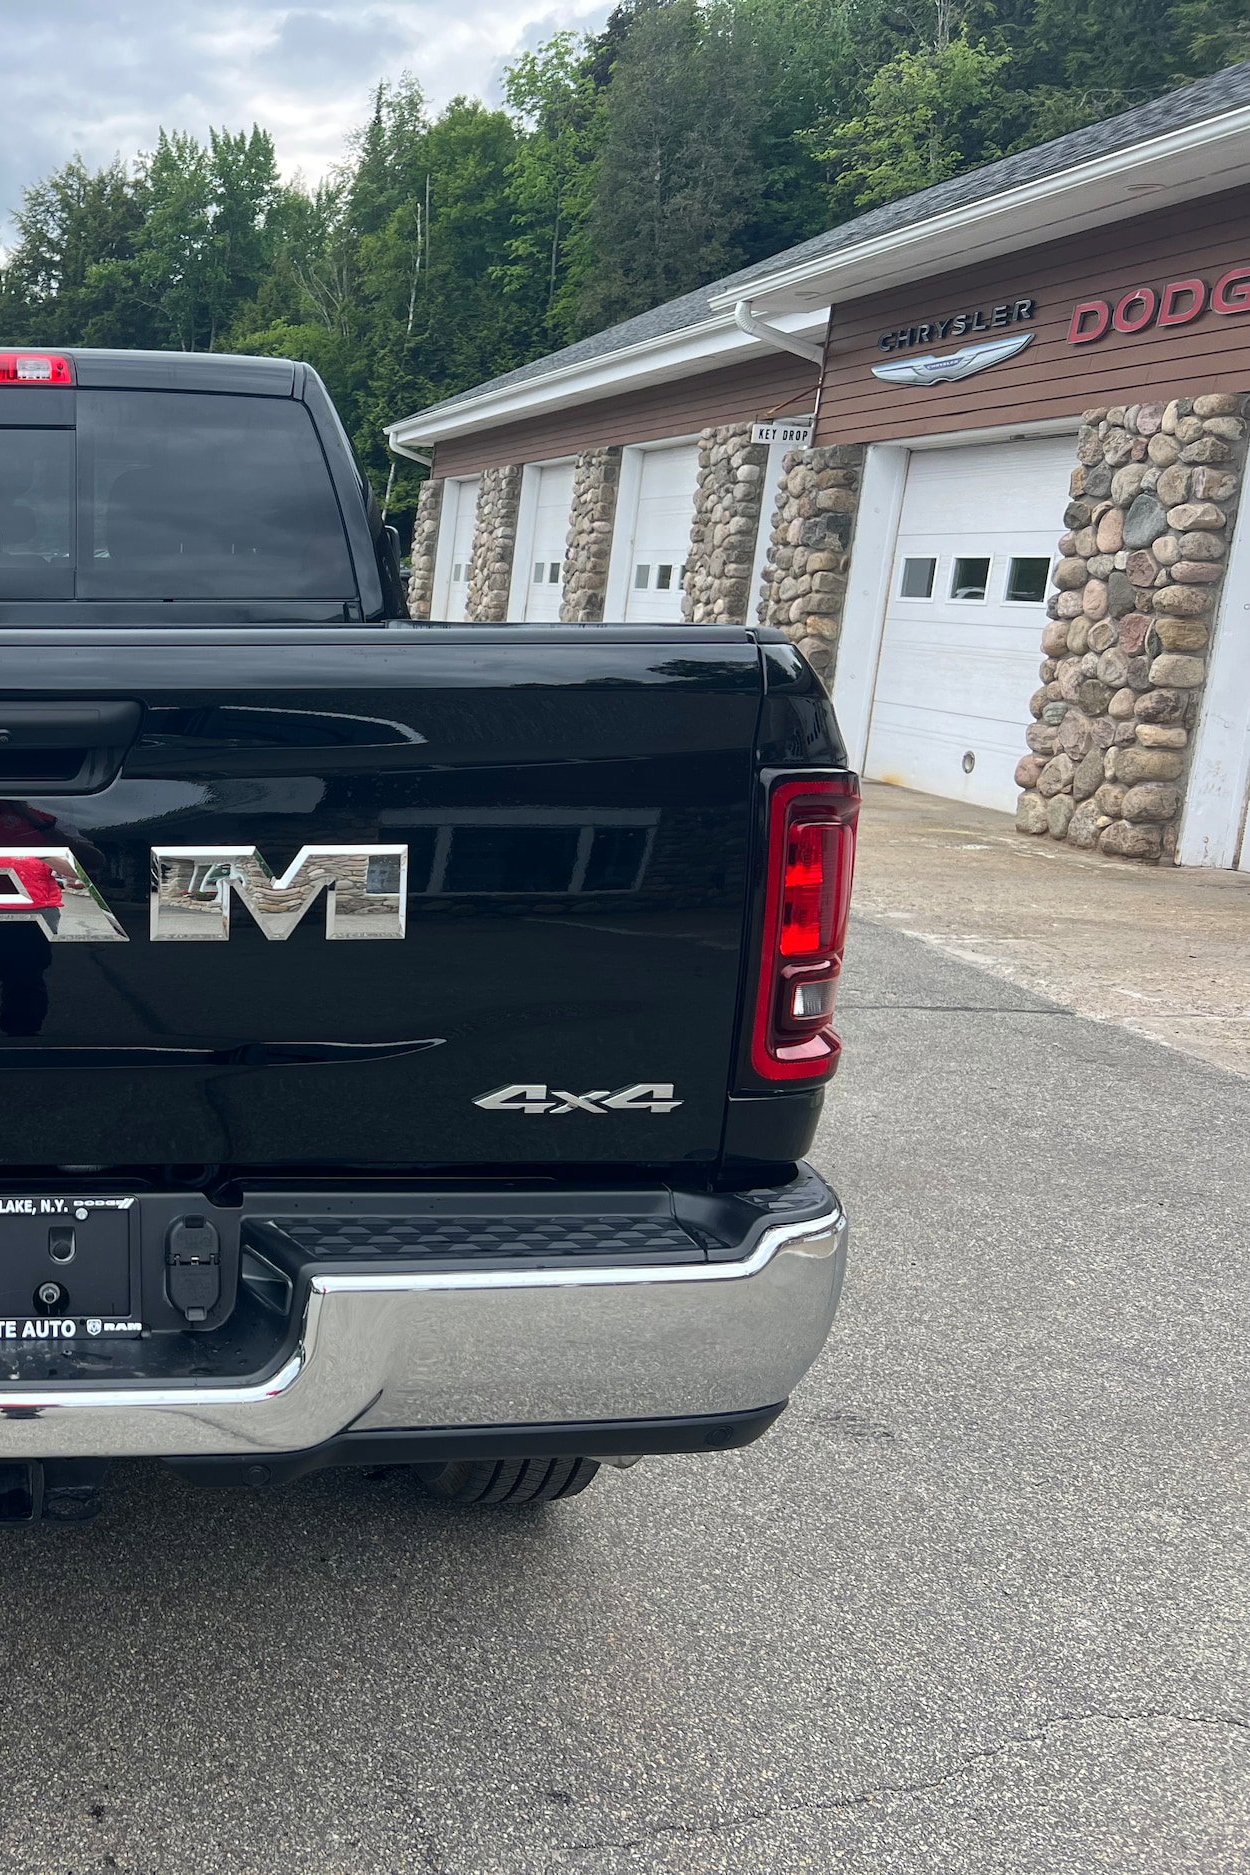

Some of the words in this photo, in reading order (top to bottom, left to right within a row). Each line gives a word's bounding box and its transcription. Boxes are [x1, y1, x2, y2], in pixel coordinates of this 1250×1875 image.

[878, 299, 1034, 352] CHRYSLER
[758, 428, 777, 440] KEY
[782, 429, 808, 441] DROP
[471, 1083, 683, 1114] 4x4
[40, 1199, 68, 1213] N.Y.
[22, 1320, 76, 1338] AUTO
[103, 1322, 142, 1331] RAM
